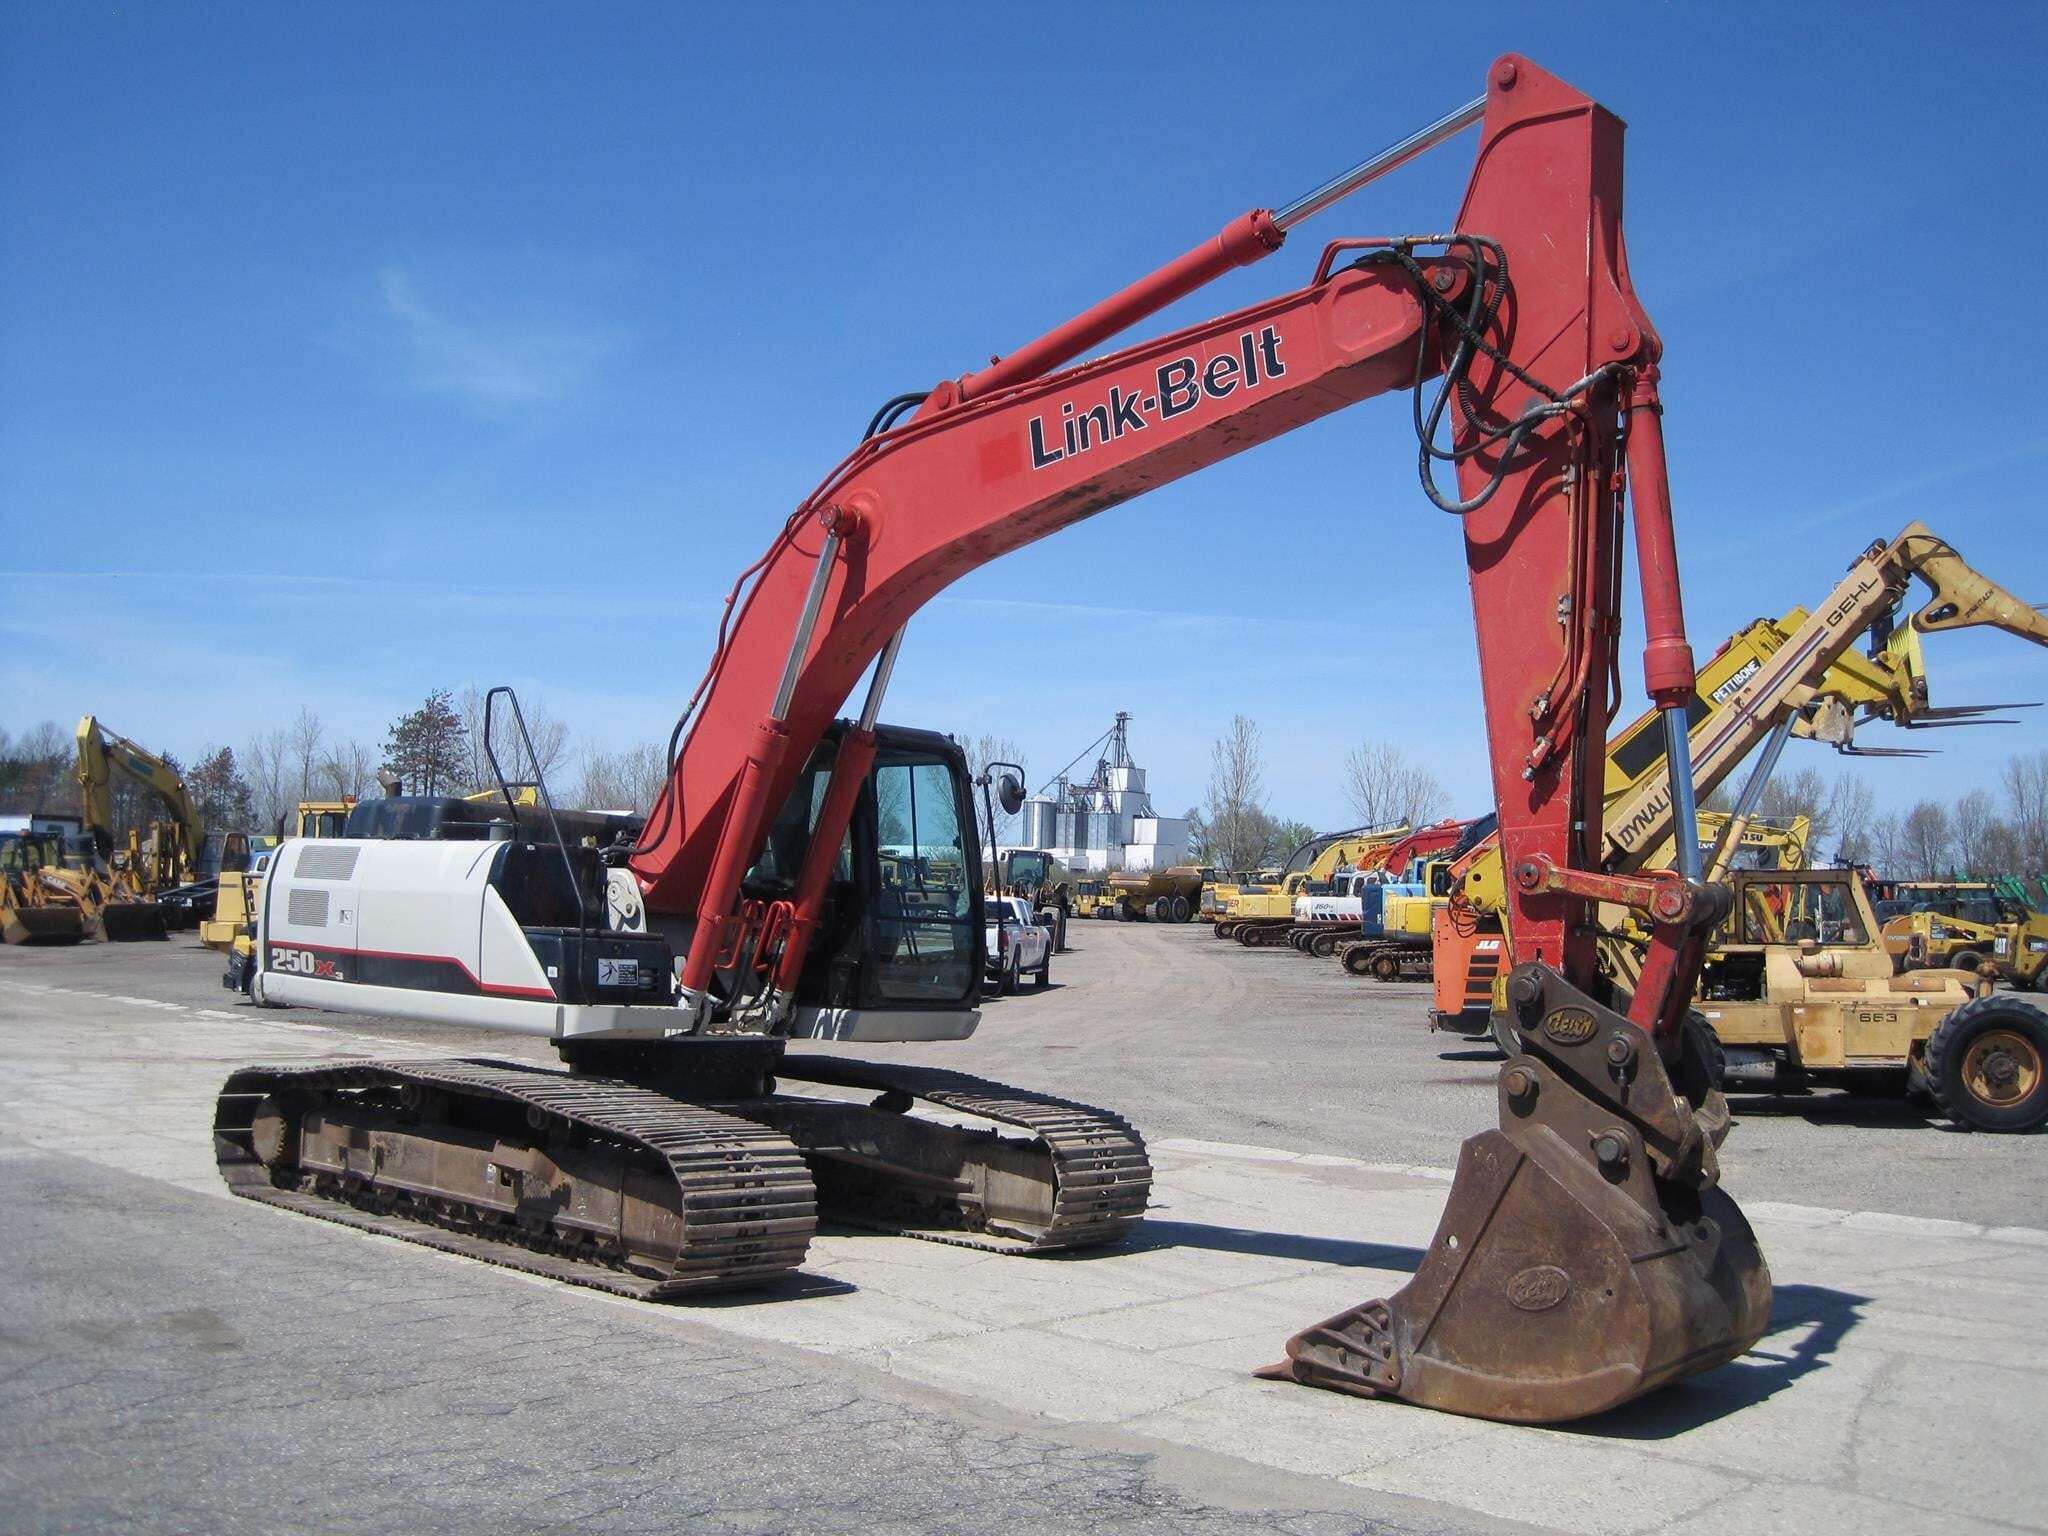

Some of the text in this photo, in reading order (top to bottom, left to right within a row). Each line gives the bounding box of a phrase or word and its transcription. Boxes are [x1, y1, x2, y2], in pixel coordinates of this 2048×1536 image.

[1028, 324, 1287, 471] Link-Belt
[1826, 577, 1879, 627] GEHL
[1712, 659, 1760, 705] PETTIBONE
[1618, 783, 1672, 849] DYNALI
[1475, 940, 1500, 950] JLG
[1994, 937, 2007, 954] CAT
